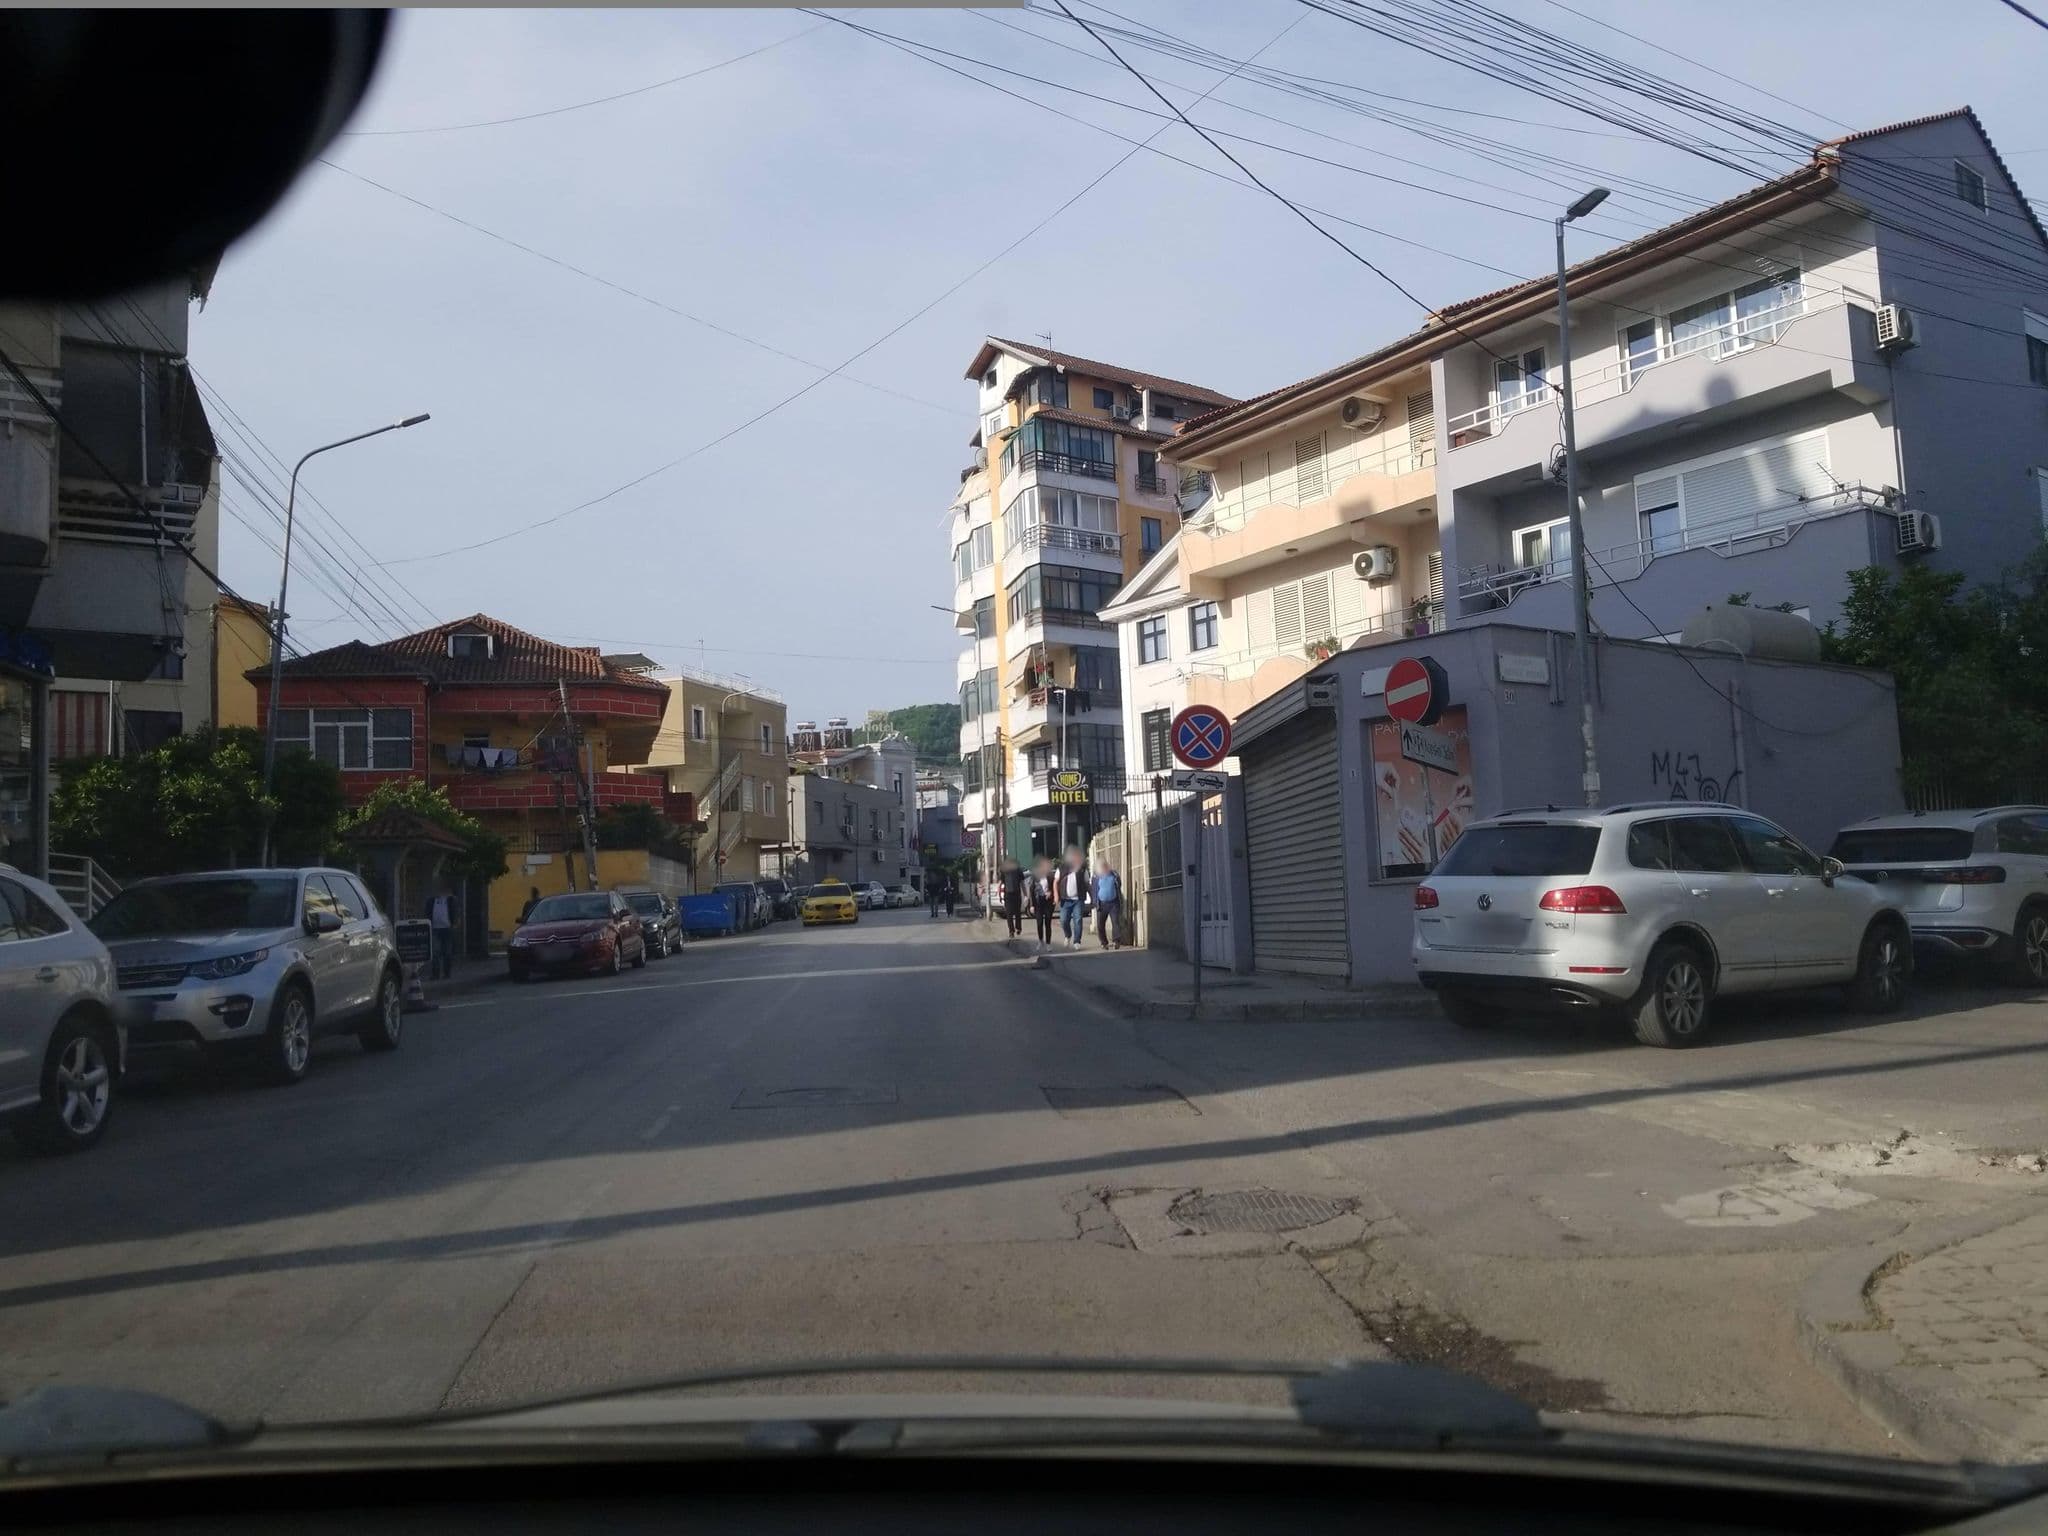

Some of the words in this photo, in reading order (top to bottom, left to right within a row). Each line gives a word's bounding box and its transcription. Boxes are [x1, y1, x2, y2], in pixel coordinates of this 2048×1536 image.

[862, 721, 894, 733] Hotel
[1374, 721, 1401, 736] PAR
[1059, 773, 1079, 788] HOME
[1051, 790, 1089, 804] HOTEL
